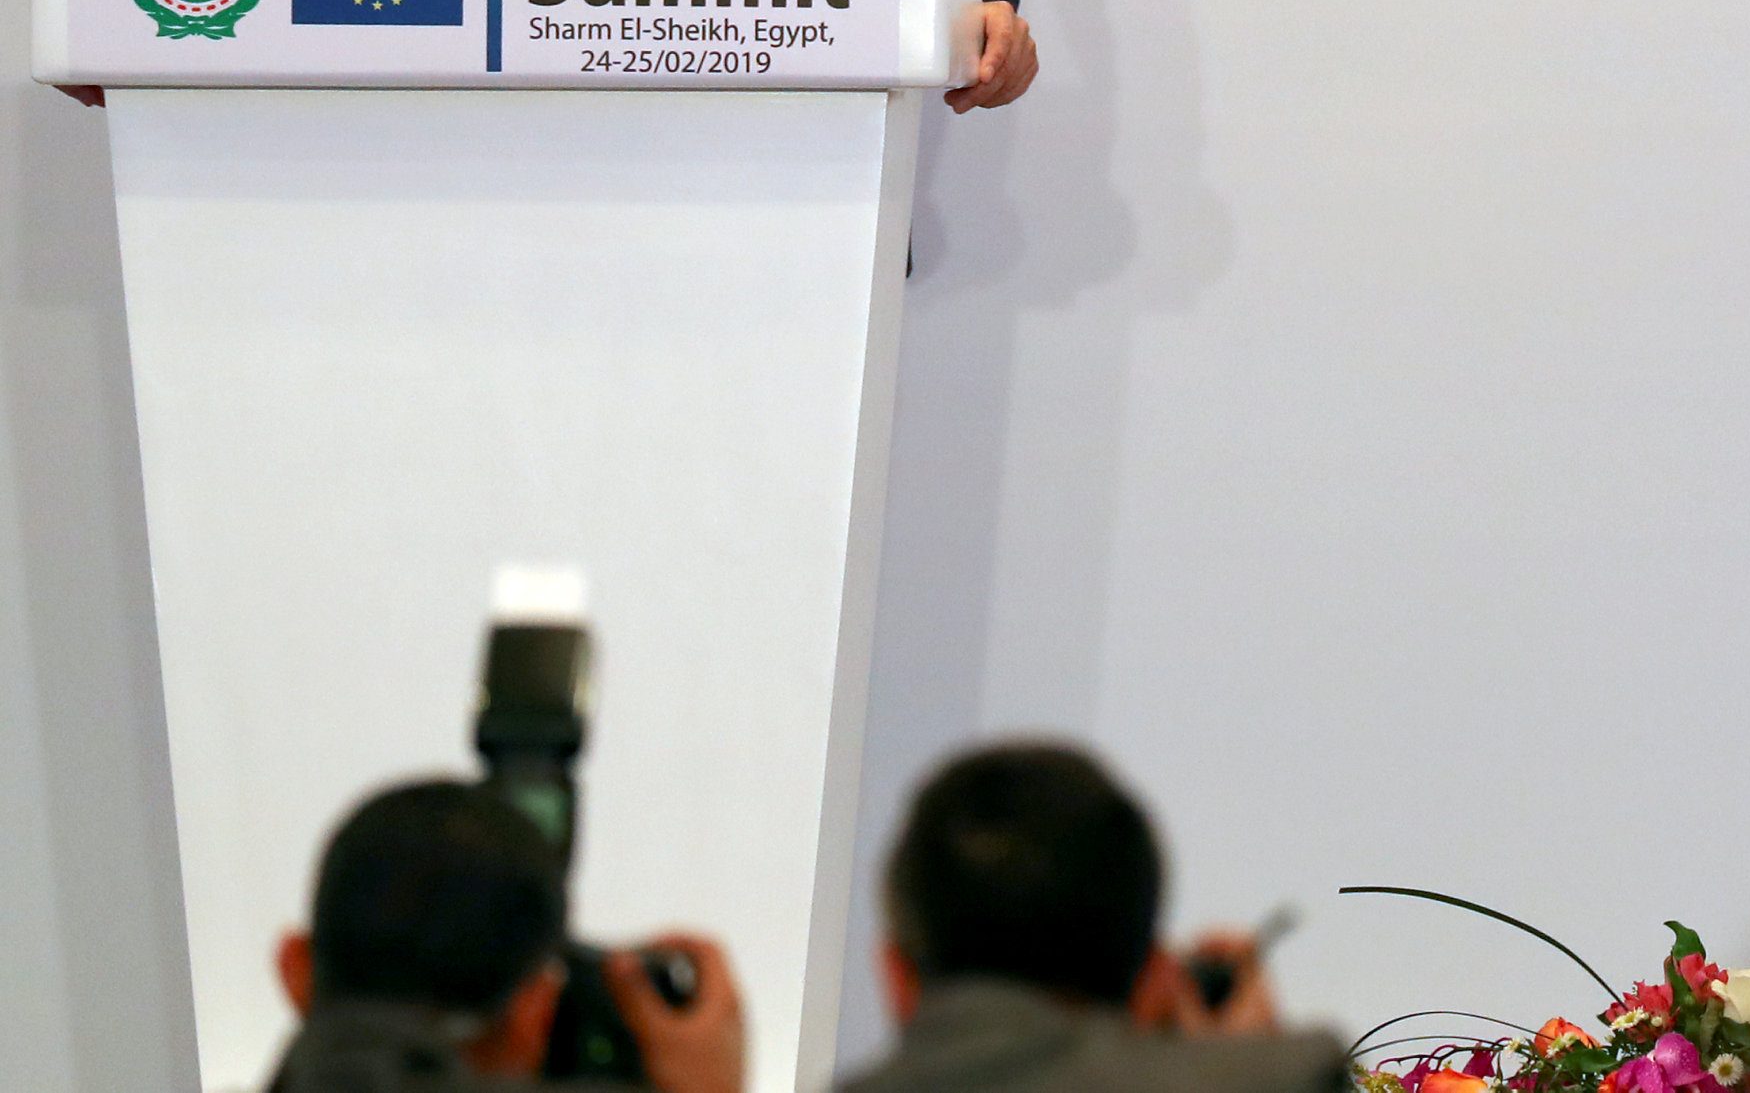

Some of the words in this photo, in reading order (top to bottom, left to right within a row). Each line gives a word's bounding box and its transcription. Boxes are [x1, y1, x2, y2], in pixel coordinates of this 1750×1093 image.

[530, 16, 613, 40] Sharm
[621, 17, 747, 46] El-Sheikh,
[755, 19, 836, 48] Egypt,
[581, 50, 773, 75] 24-25/02/2019
